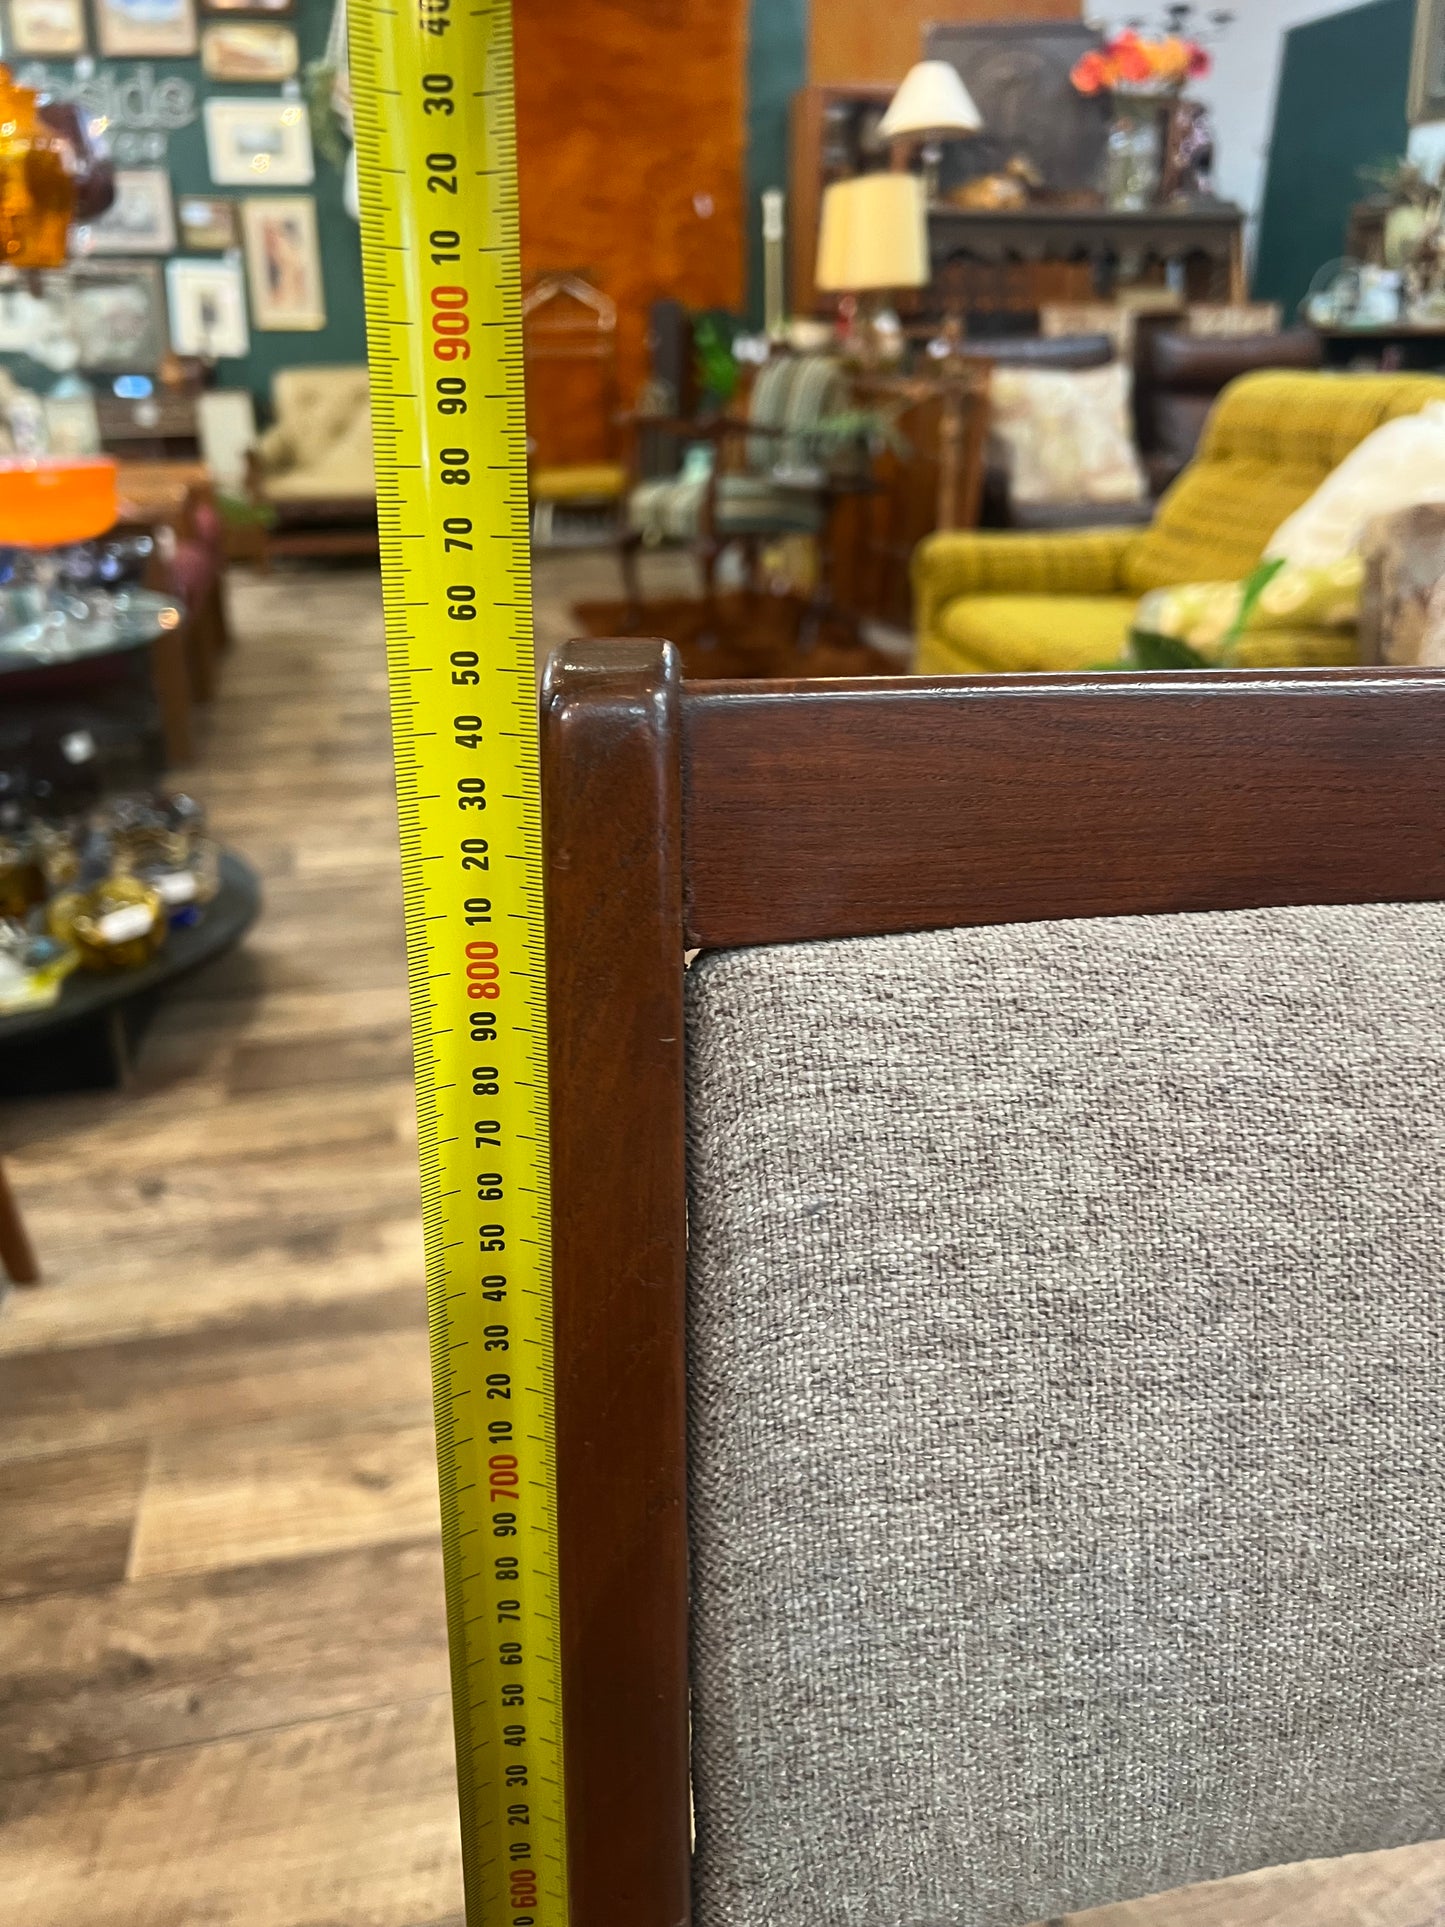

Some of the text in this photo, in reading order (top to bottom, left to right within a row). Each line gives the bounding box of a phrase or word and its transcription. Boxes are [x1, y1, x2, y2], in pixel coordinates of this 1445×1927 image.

[422, 74, 455, 117] 30
[425, 153, 458, 195] 20
[429, 230, 461, 266] 10
[430, 286, 471, 362] 900
[436, 377, 468, 415] 90
[439, 448, 471, 486] 80
[442, 517, 474, 553] 70
[446, 585, 477, 621] 60
[449, 651, 480, 686] 50
[453, 715, 483, 750] 40
[457, 777, 487, 811] 30
[460, 838, 490, 871] 20
[463, 897, 492, 927] 10
[465, 941, 501, 1000] 800
[469, 1011, 498, 1042] 90
[471, 1066, 500, 1096] 80
[474, 1120, 502, 1149] 70
[476, 1172, 504, 1201] 60
[478, 1224, 506, 1252] 50
[480, 1274, 507, 1303] 40
[482, 1324, 510, 1352] 30
[485, 1373, 512, 1400] 20
[487, 1420, 513, 1445] 10
[487, 1454, 520, 1503] 700
[491, 1512, 518, 1538] 90
[493, 1556, 520, 1581] 80
[496, 1599, 521, 1624] 70
[498, 1641, 523, 1666] 60
[500, 1683, 525, 1707] 50
[502, 1724, 527, 1747] 40
[504, 1764, 529, 1788] 30
[506, 1803, 530, 1827] 20
[508, 1842, 532, 1862] 10
[509, 1868, 538, 1909] 600
